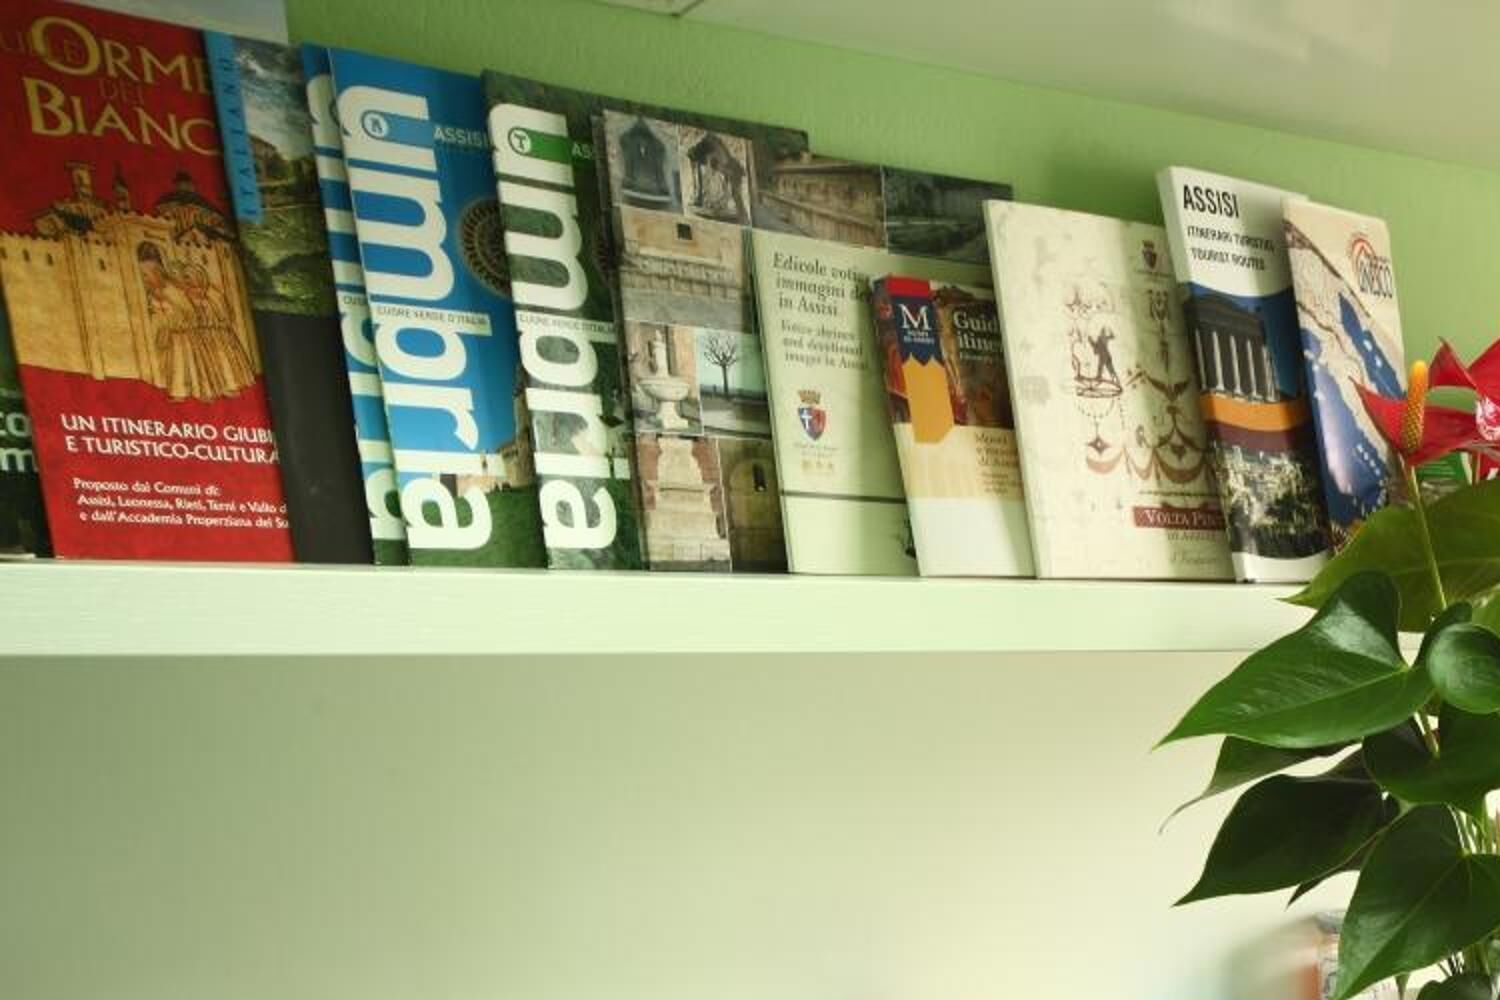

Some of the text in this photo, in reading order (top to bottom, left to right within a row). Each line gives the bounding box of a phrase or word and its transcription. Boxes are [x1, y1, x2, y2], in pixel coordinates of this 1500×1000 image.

[1183, 184, 1240, 219] ASSISI
[1187, 225, 1234, 245] ITINERARI
[774, 252, 827, 276] Edicole
[1191, 247, 1230, 264] TOURIST
[61, 413, 95, 432] UN
[102, 416, 217, 440] ITINERARIO
[66, 436, 79, 453] E
[73, 477, 129, 493] Proposto
[132, 481, 150, 493] dai
[154, 481, 201, 496] Comuni
